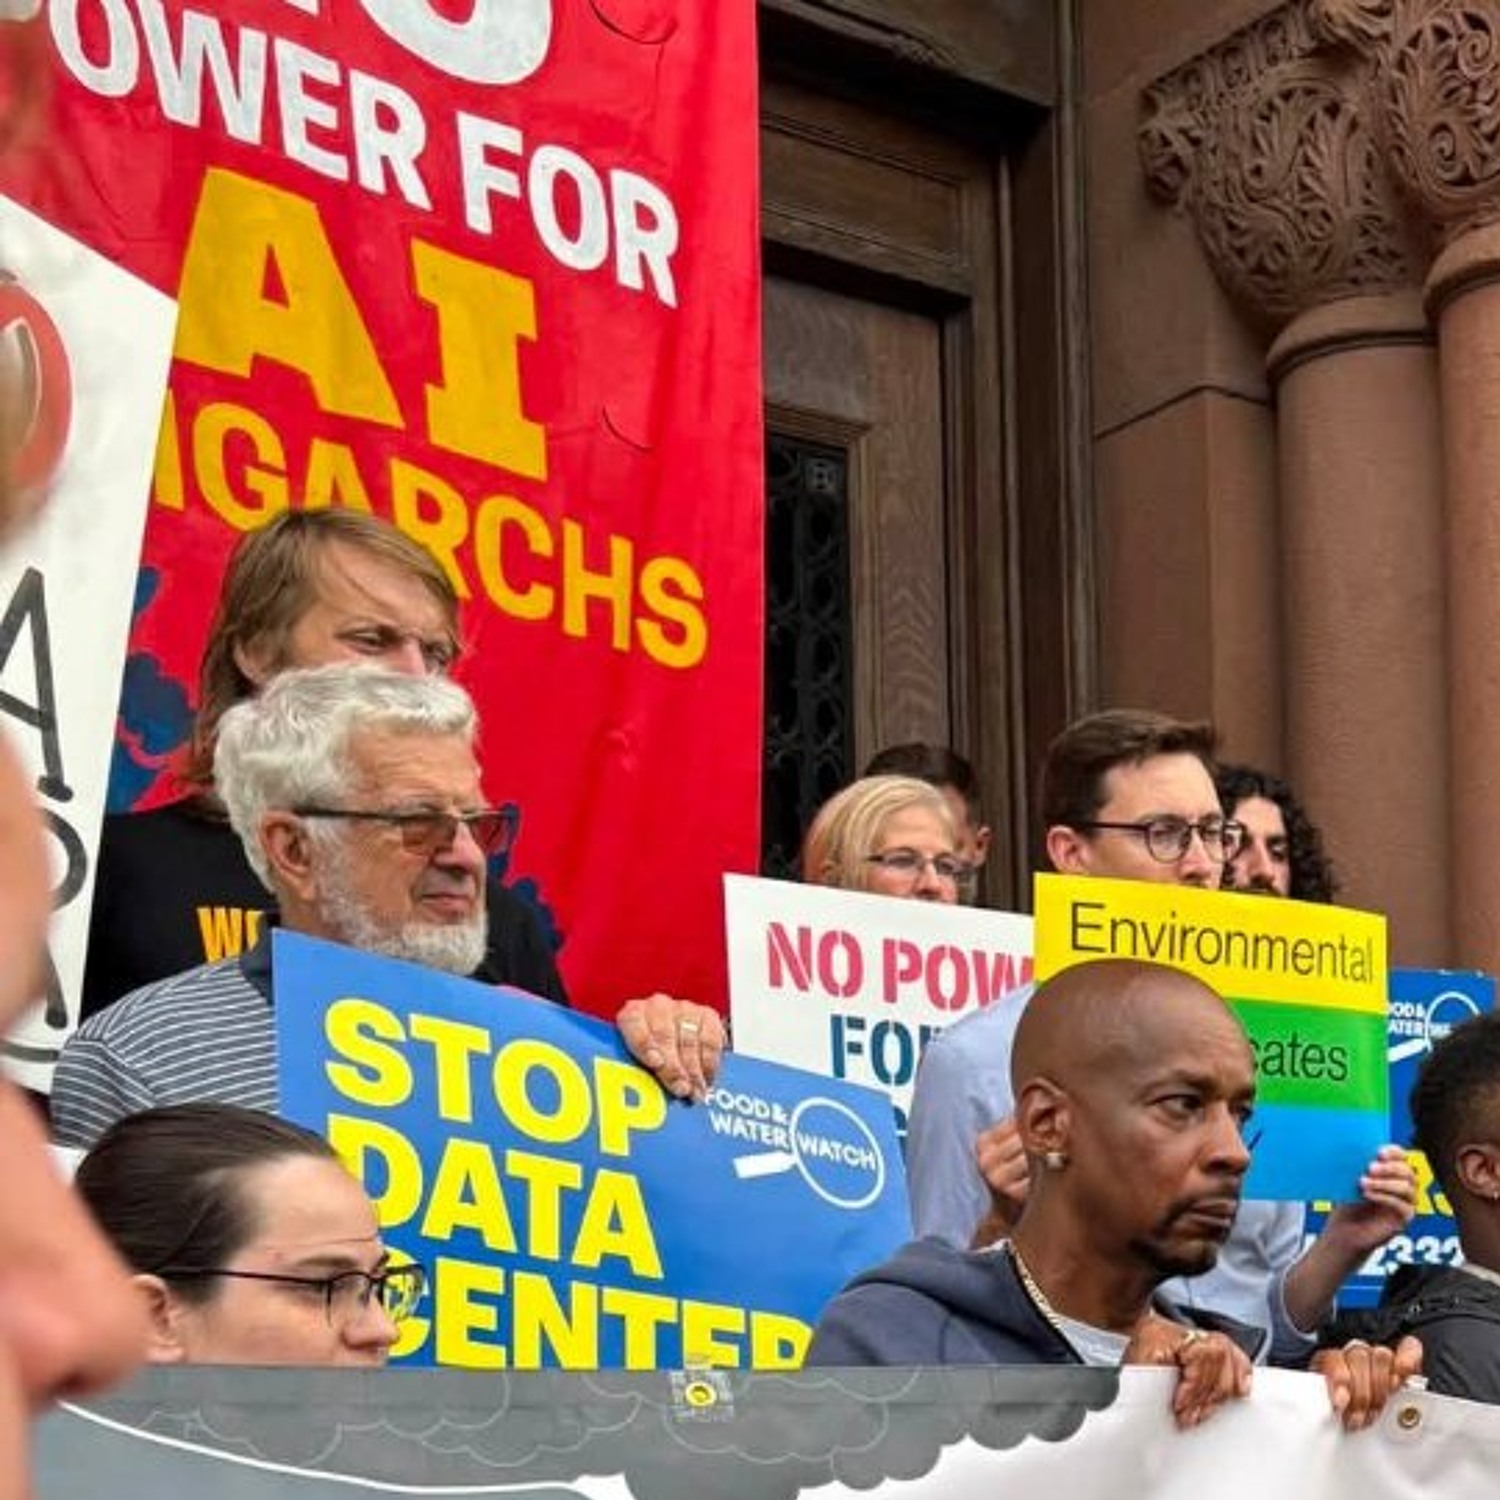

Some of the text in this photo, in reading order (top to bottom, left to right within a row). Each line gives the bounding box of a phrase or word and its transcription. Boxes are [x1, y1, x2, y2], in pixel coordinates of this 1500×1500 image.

[0, 0, 433, 211] OWER
[456, 111, 680, 309] FOR
[171, 166, 547, 480] AI
[153, 387, 708, 668] IGARCHS
[767, 922, 1035, 1011] NO POW
[1071, 902, 1374, 984] Environmental
[324, 997, 668, 1157] STOP
[830, 1013, 948, 1086] FO
[327, 1113, 664, 1279] DATA
[708, 1110, 790, 1150] WATER
[797, 1131, 877, 1172] WATCH
